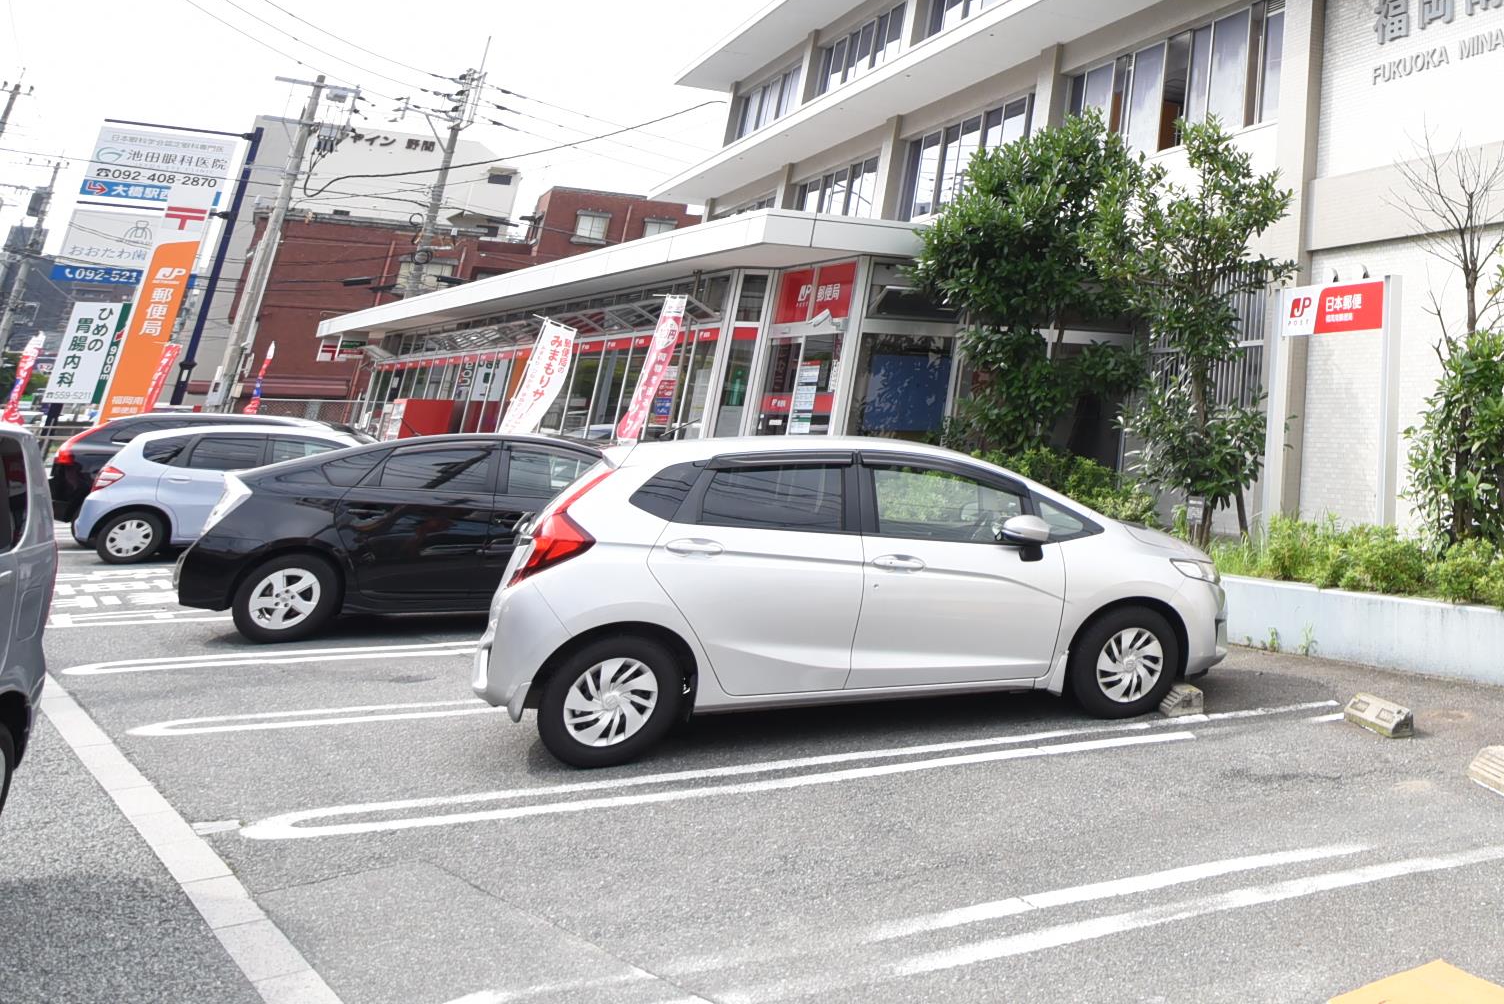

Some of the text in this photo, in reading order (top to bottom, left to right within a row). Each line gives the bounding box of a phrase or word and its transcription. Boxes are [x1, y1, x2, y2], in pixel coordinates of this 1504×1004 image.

[1371, 45, 1449, 85] FUKUOKA
[126, 149, 229, 171] 池田眼科医院
[111, 168, 217, 188] 092-408-2870
[139, 287, 174, 337] 郵便局
[1290, 296, 1312, 318] JP
[1325, 293, 1363, 312] 日本郵便
[88, 307, 114, 352] ひめの
[56, 317, 94, 388] 胃腸内科
